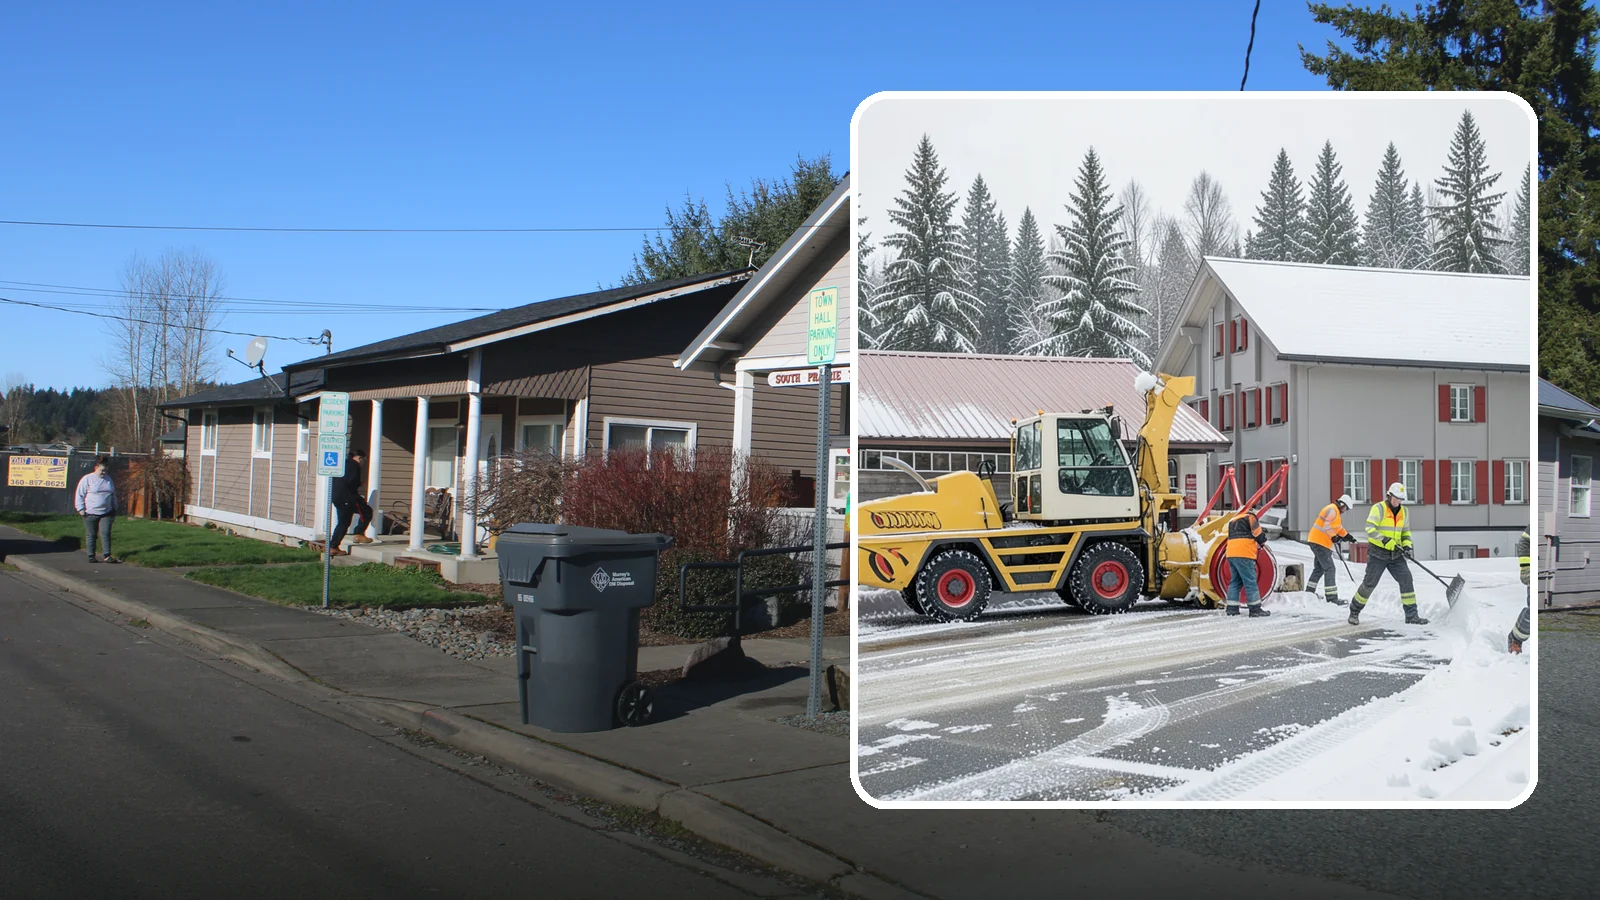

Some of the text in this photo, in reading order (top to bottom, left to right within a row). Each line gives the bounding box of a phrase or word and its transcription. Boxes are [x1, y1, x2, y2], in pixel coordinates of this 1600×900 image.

[815, 295, 833, 308] TOWN
[814, 312, 831, 325] HALL
[810, 327, 835, 340] PARKING
[814, 344, 831, 357] ONLY
[775, 373, 801, 384] SOUTH
